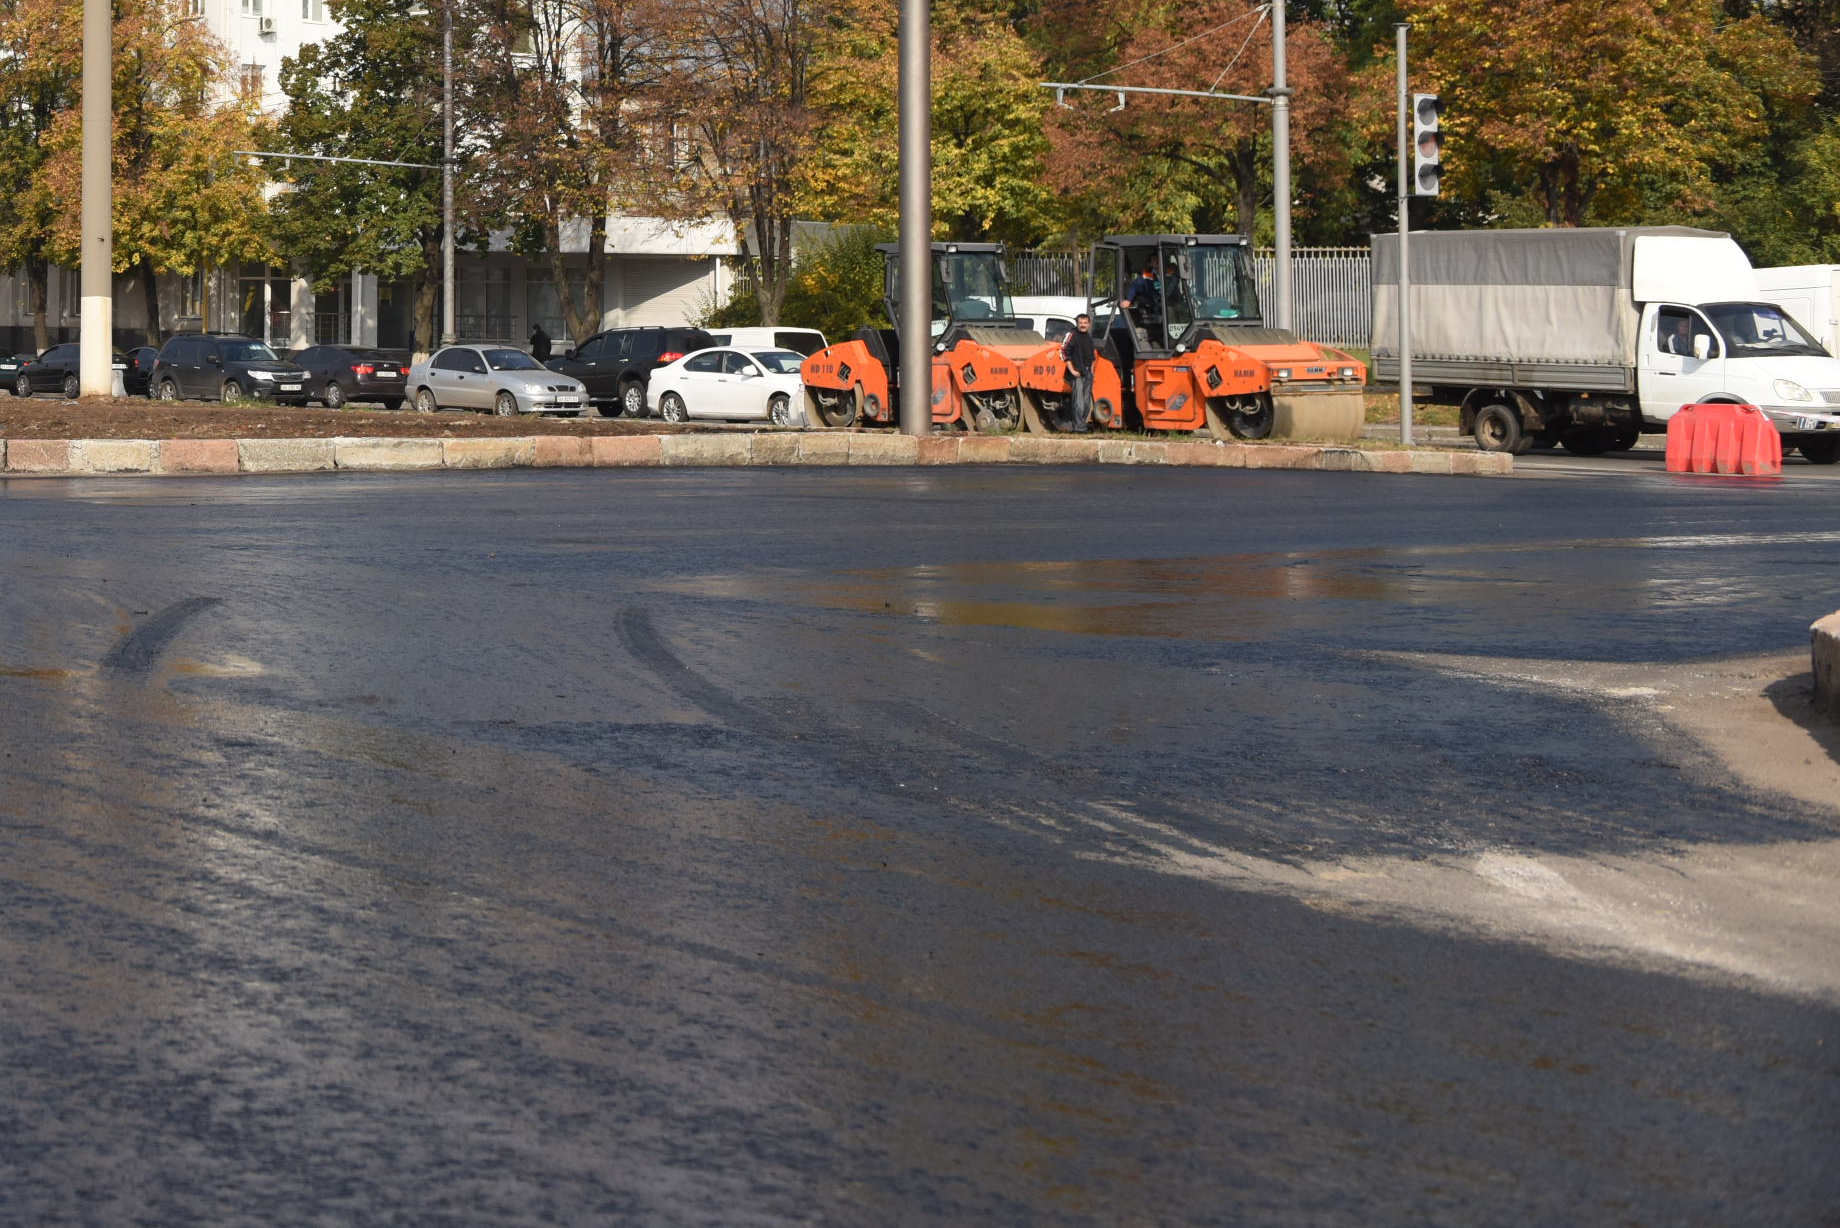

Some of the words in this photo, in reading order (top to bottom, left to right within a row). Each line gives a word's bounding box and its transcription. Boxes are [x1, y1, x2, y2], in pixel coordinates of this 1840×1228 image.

[1033, 365, 1044, 375] HD
[1046, 365, 1056, 375] 90
[1234, 369, 1255, 378] HAMM
